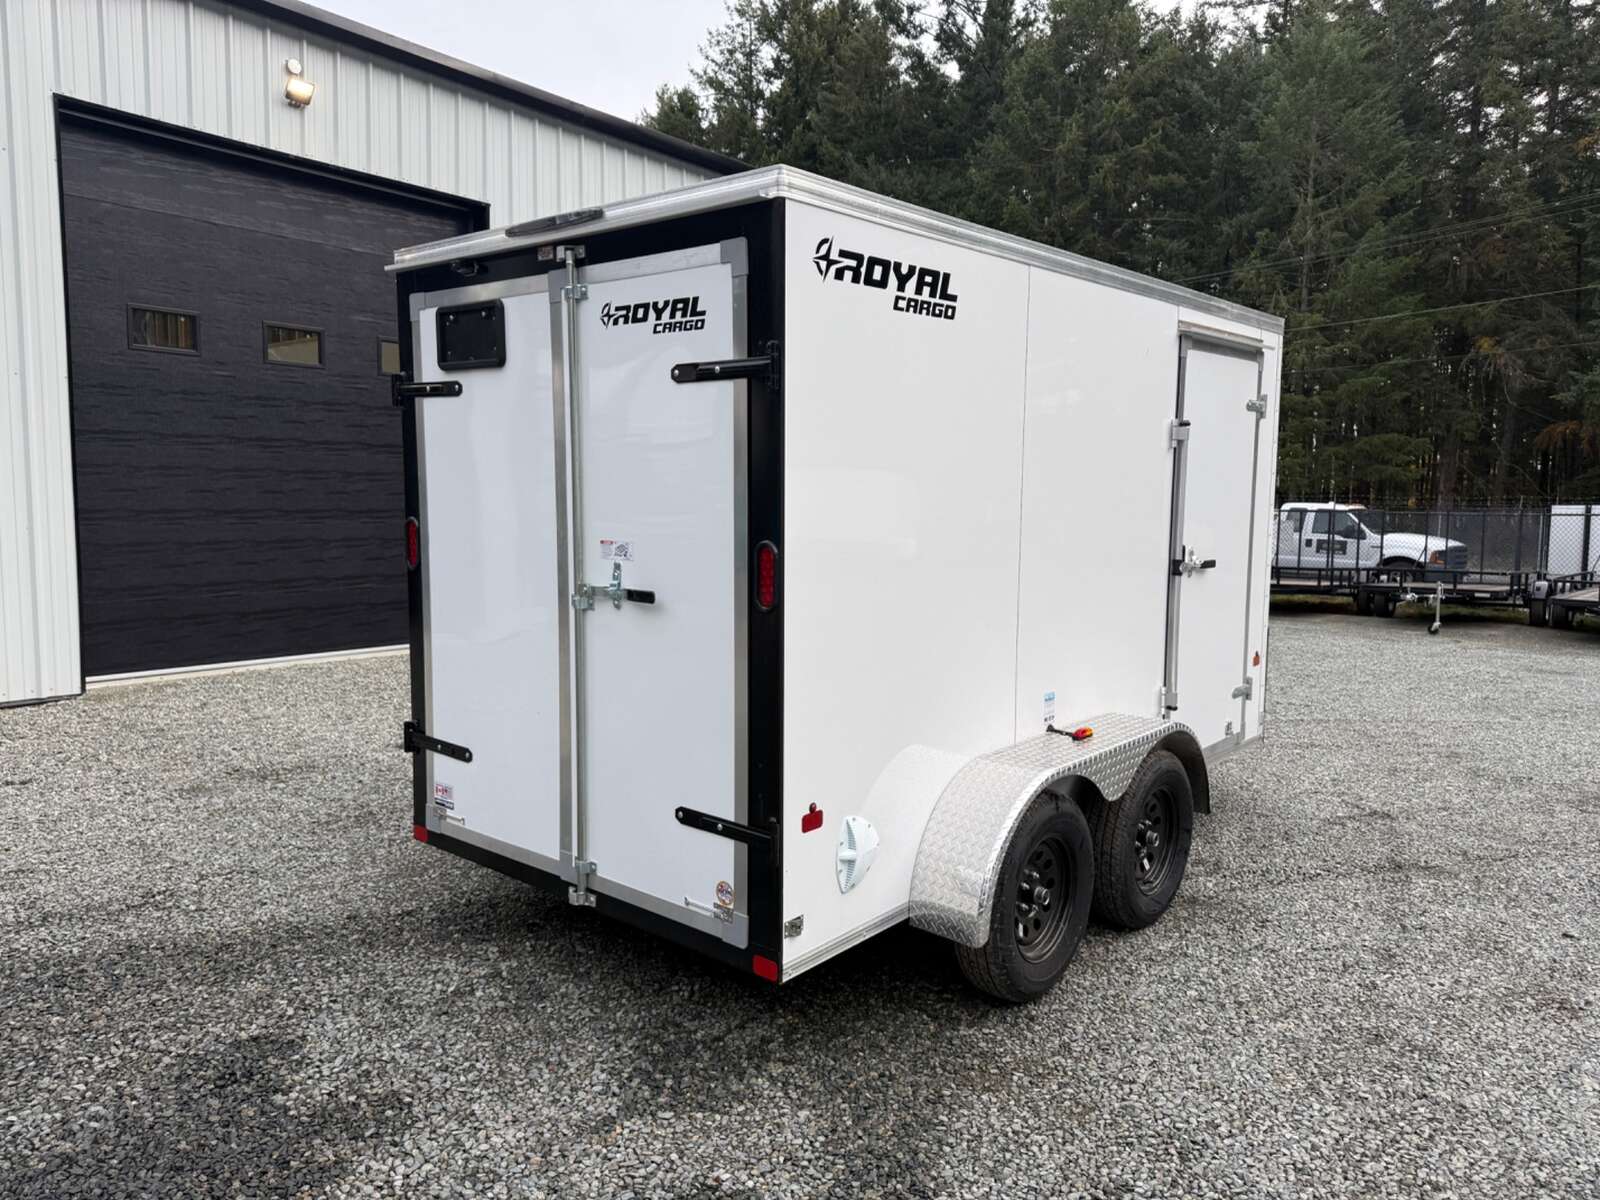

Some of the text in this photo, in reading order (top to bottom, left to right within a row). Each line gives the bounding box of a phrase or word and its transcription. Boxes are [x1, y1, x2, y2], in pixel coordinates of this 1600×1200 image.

[834, 248, 958, 302] ROYAL
[612, 295, 706, 326] ROYAL
[893, 295, 957, 320] CARGO
[652, 318, 706, 334] CARGO
